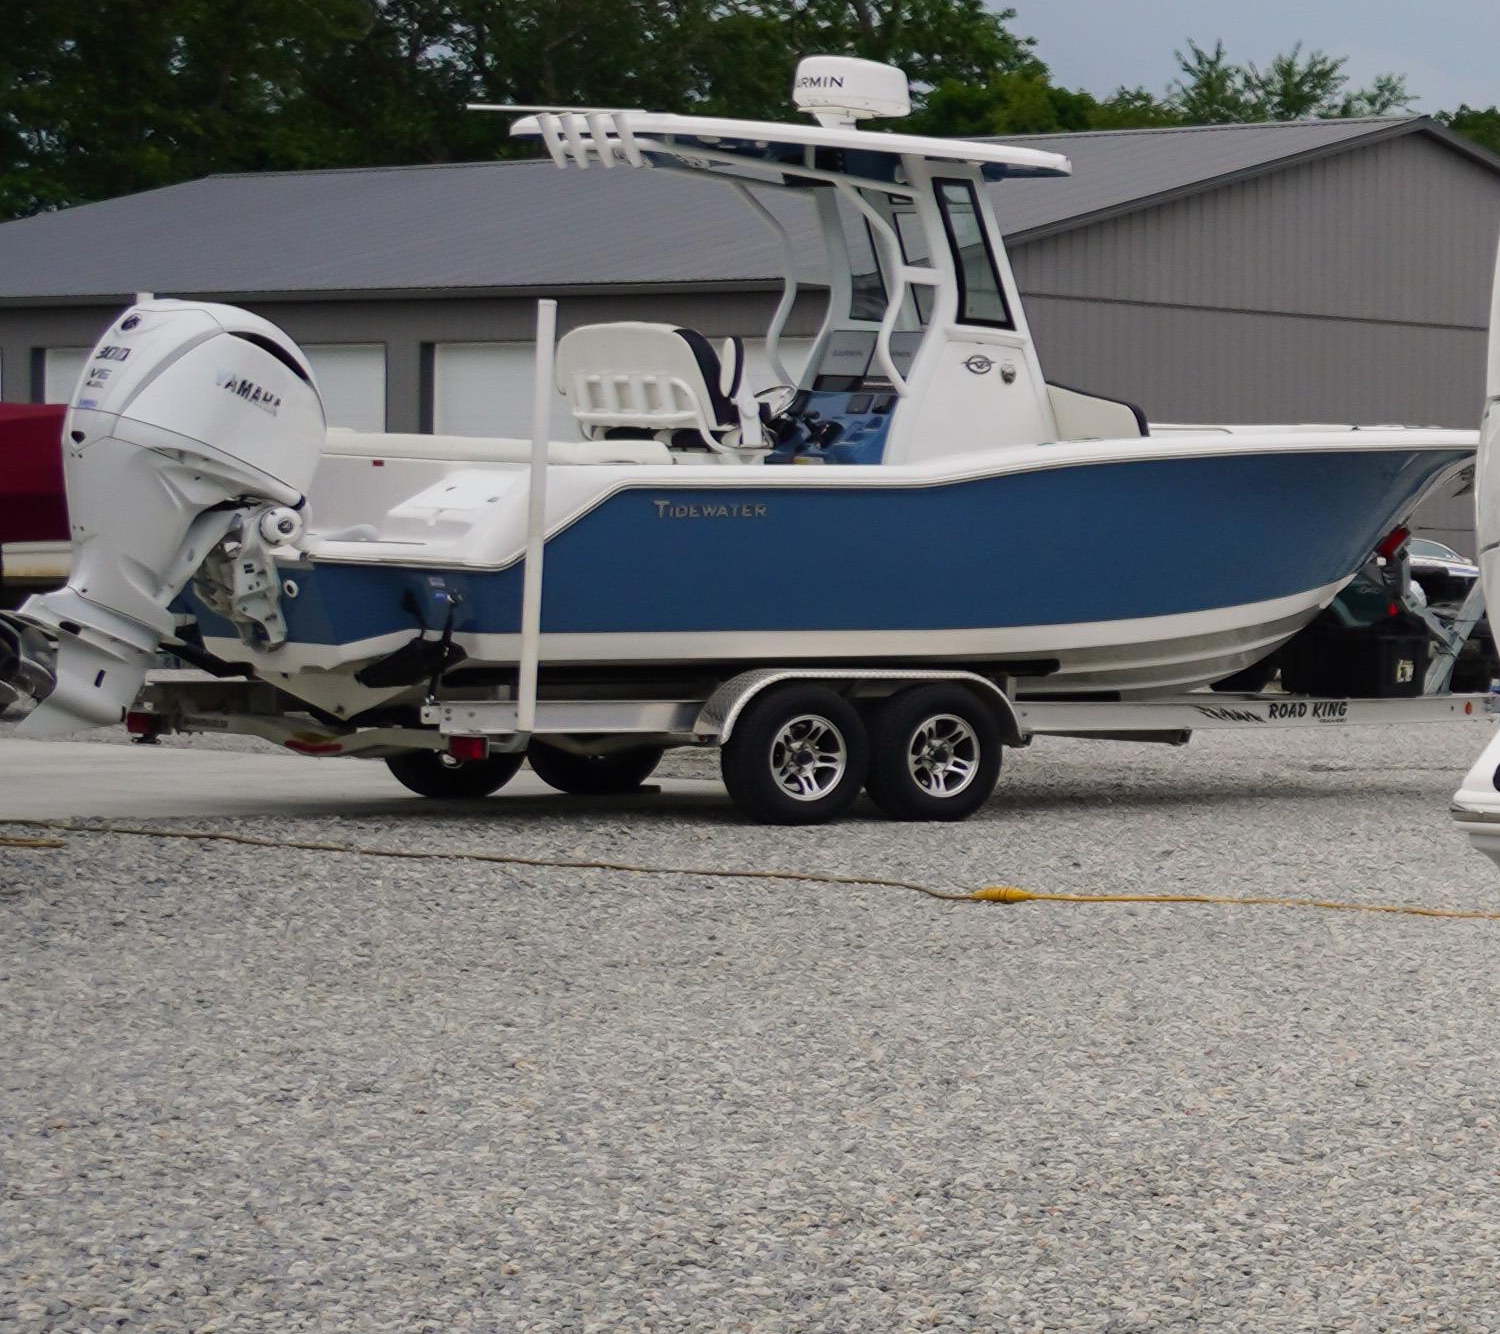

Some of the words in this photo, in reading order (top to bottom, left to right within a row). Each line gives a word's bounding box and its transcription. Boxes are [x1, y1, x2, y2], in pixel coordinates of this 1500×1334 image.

[653, 499, 768, 518] TIDEWATER
[1269, 703, 1307, 719] ROAD
[1312, 701, 1348, 718] KING
